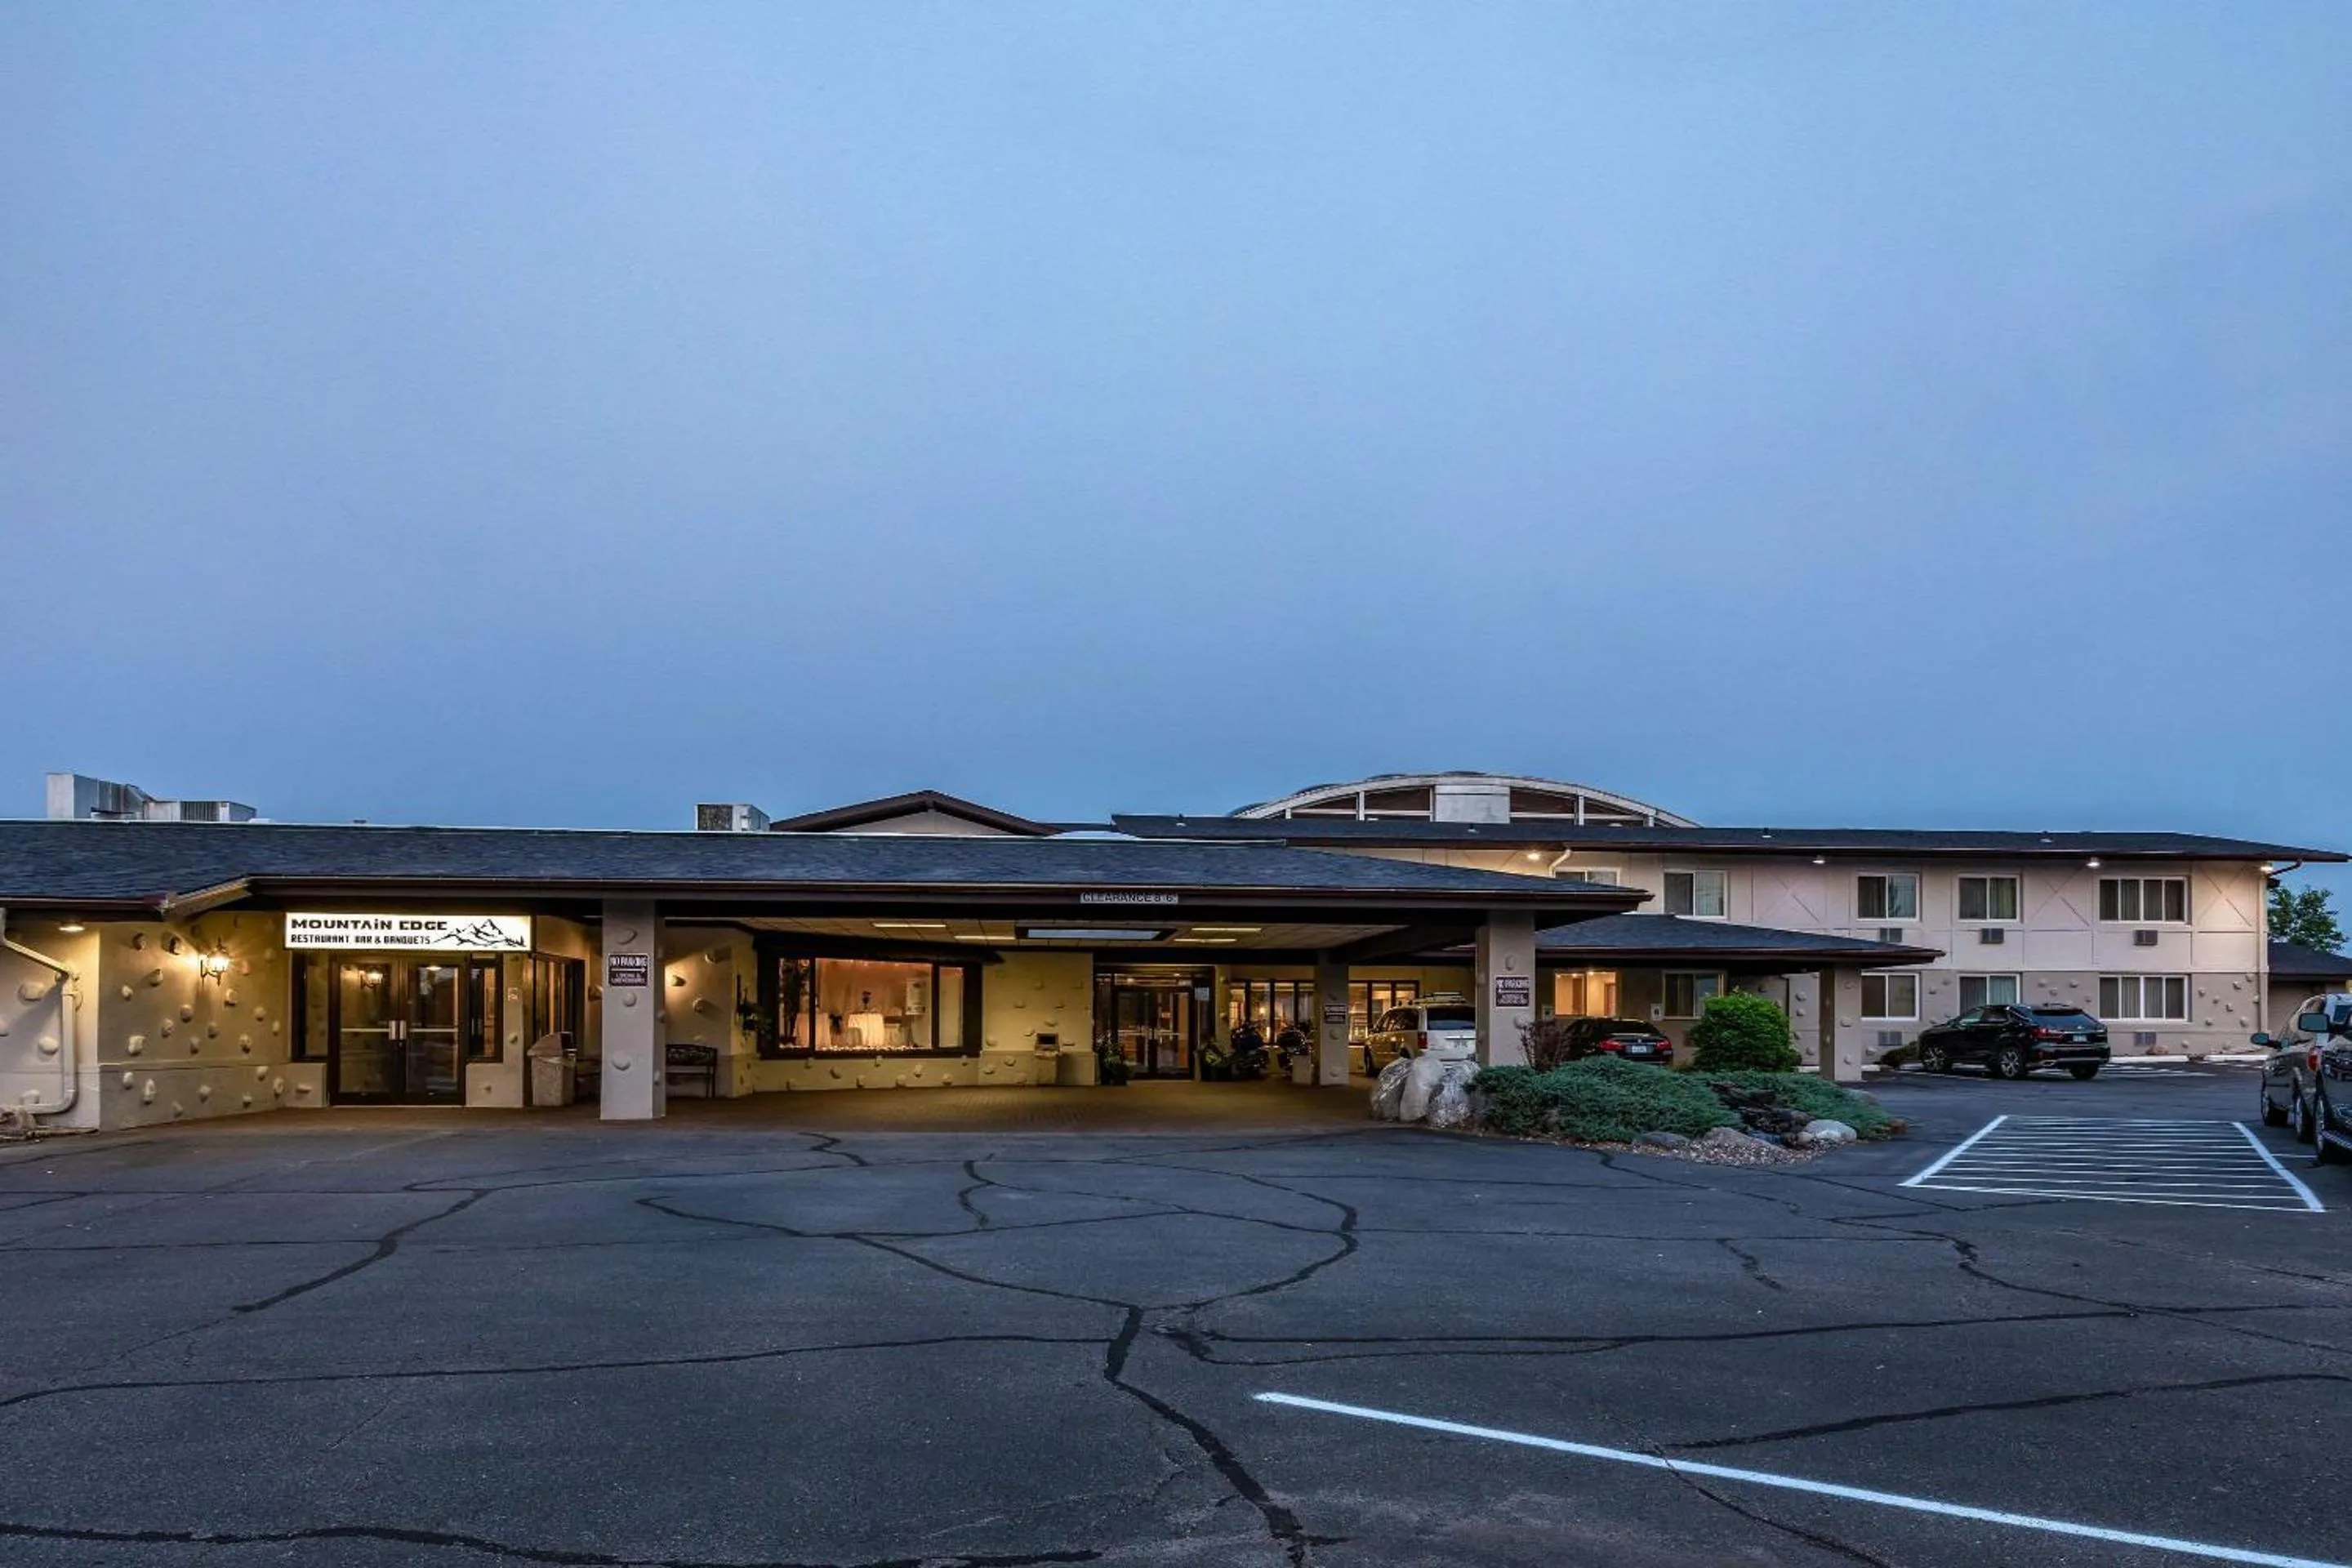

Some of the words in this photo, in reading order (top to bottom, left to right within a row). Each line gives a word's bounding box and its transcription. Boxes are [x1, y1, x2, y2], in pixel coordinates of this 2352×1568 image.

[1082, 892, 1152, 902] CLEARANCE
[399, 920, 448, 931] EDGE
[354, 935, 372, 944] BAR
[374, 936, 381, 944] &
[384, 935, 430, 945] BANQUETS
[610, 956, 620, 966] NO
[621, 956, 647, 967] PARKING
